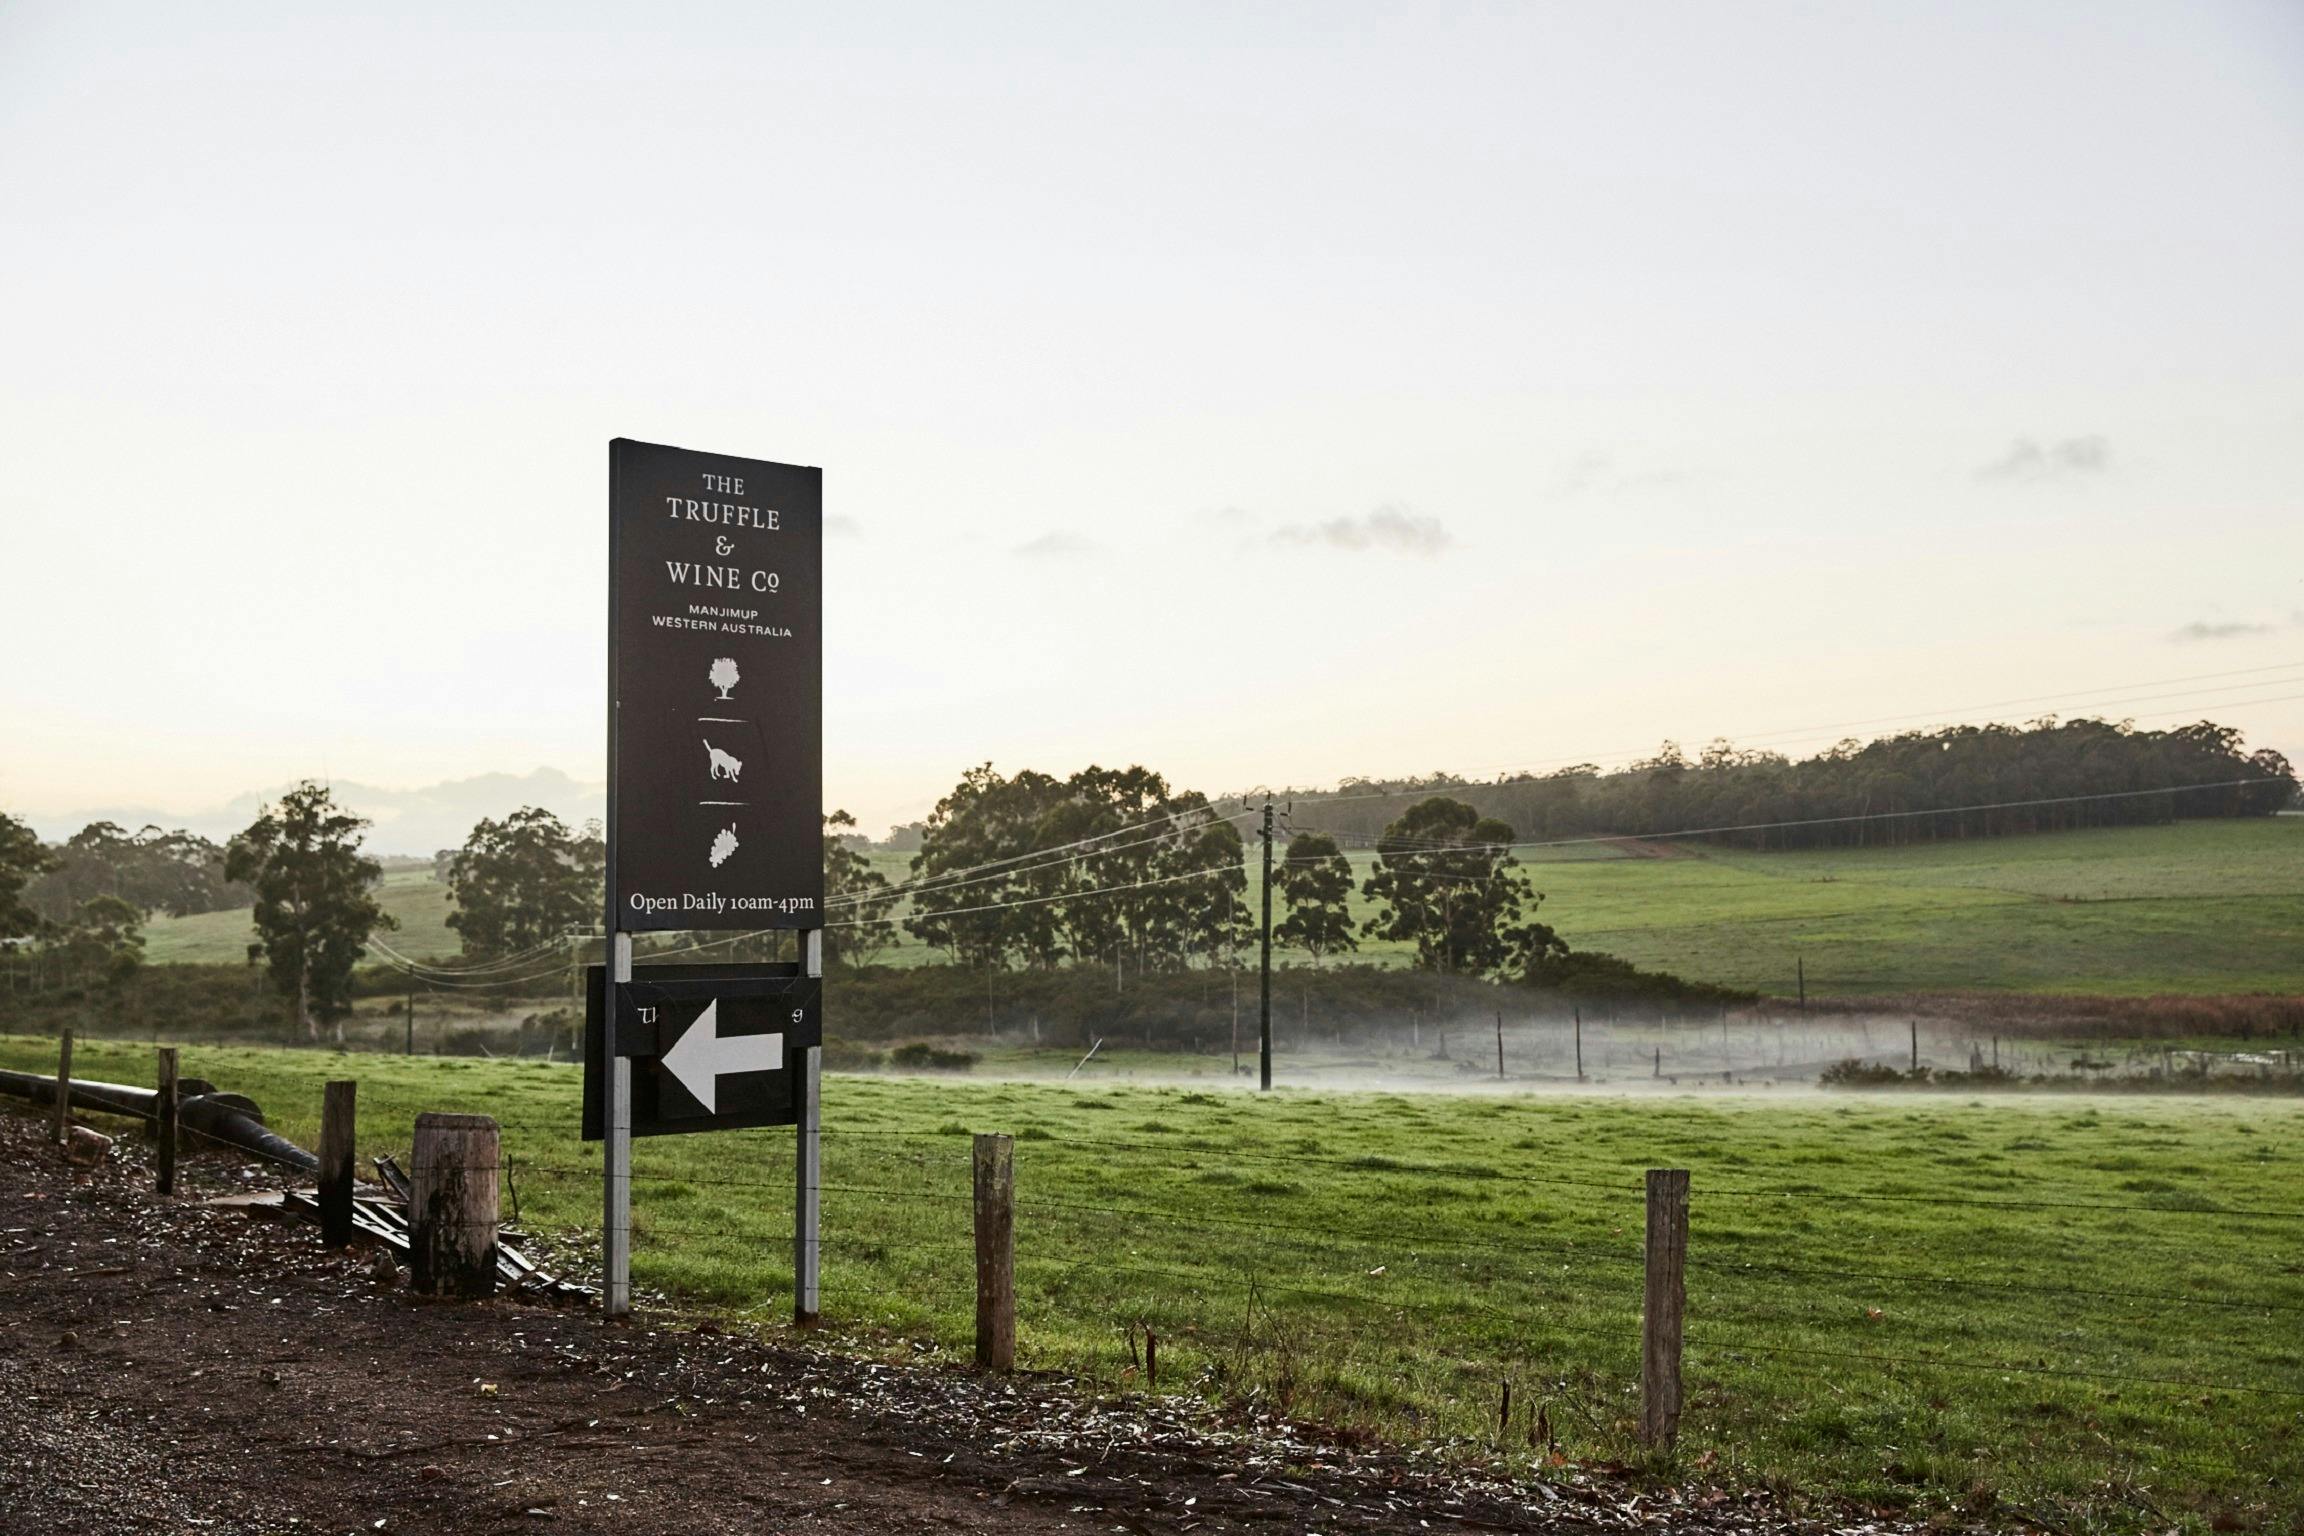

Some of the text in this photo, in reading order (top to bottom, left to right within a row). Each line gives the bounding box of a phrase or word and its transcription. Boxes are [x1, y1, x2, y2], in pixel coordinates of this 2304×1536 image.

[702, 473, 745, 496] THE
[666, 497, 780, 531] TRUFFLE
[715, 535, 735, 556] &
[665, 560, 741, 590] WINE
[689, 604, 759, 620] MANJIMUP
[652, 615, 792, 638] WESTERN AUSTRALIA
[630, 892, 815, 914] Open Daily 10am-4pm
